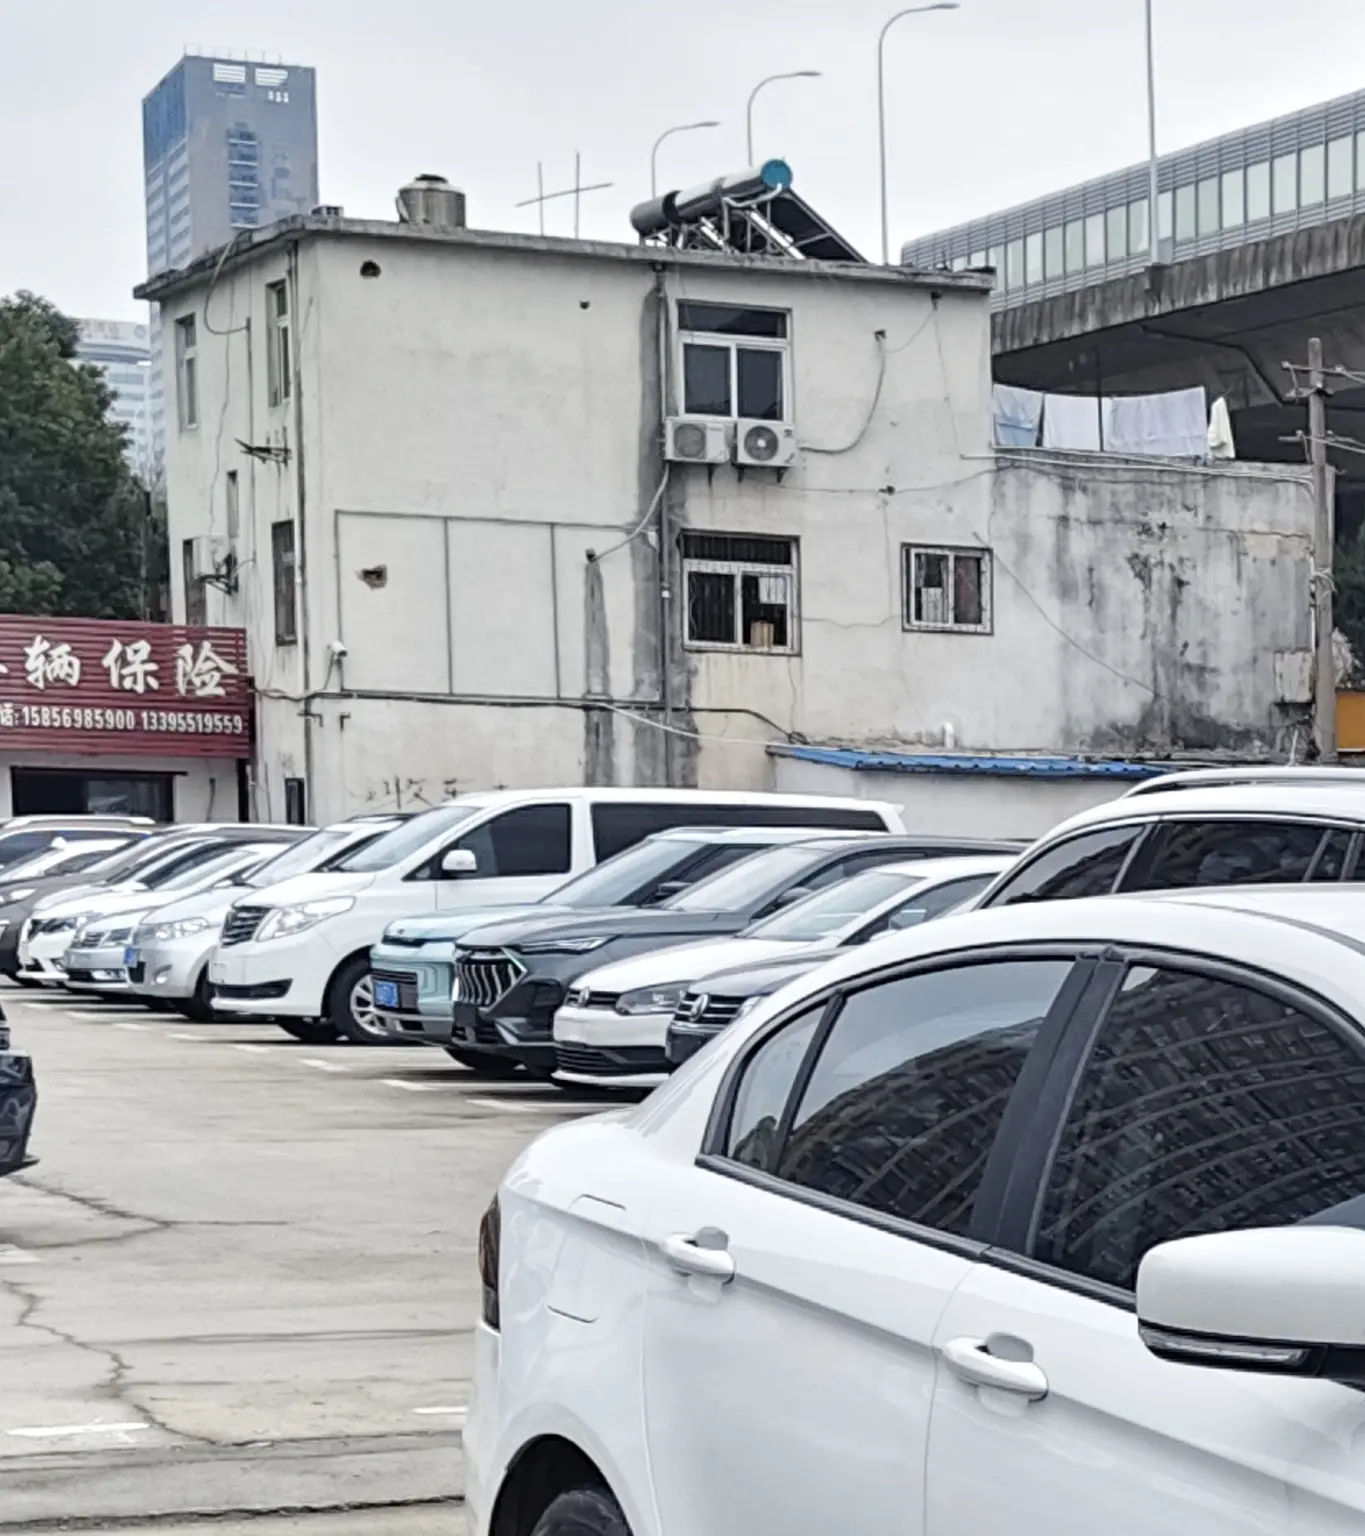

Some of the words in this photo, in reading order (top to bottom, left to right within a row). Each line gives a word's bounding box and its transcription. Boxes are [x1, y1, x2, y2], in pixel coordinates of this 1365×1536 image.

[0, 634, 240, 699] 辆保险
[141, 710, 243, 735] 13395519559
